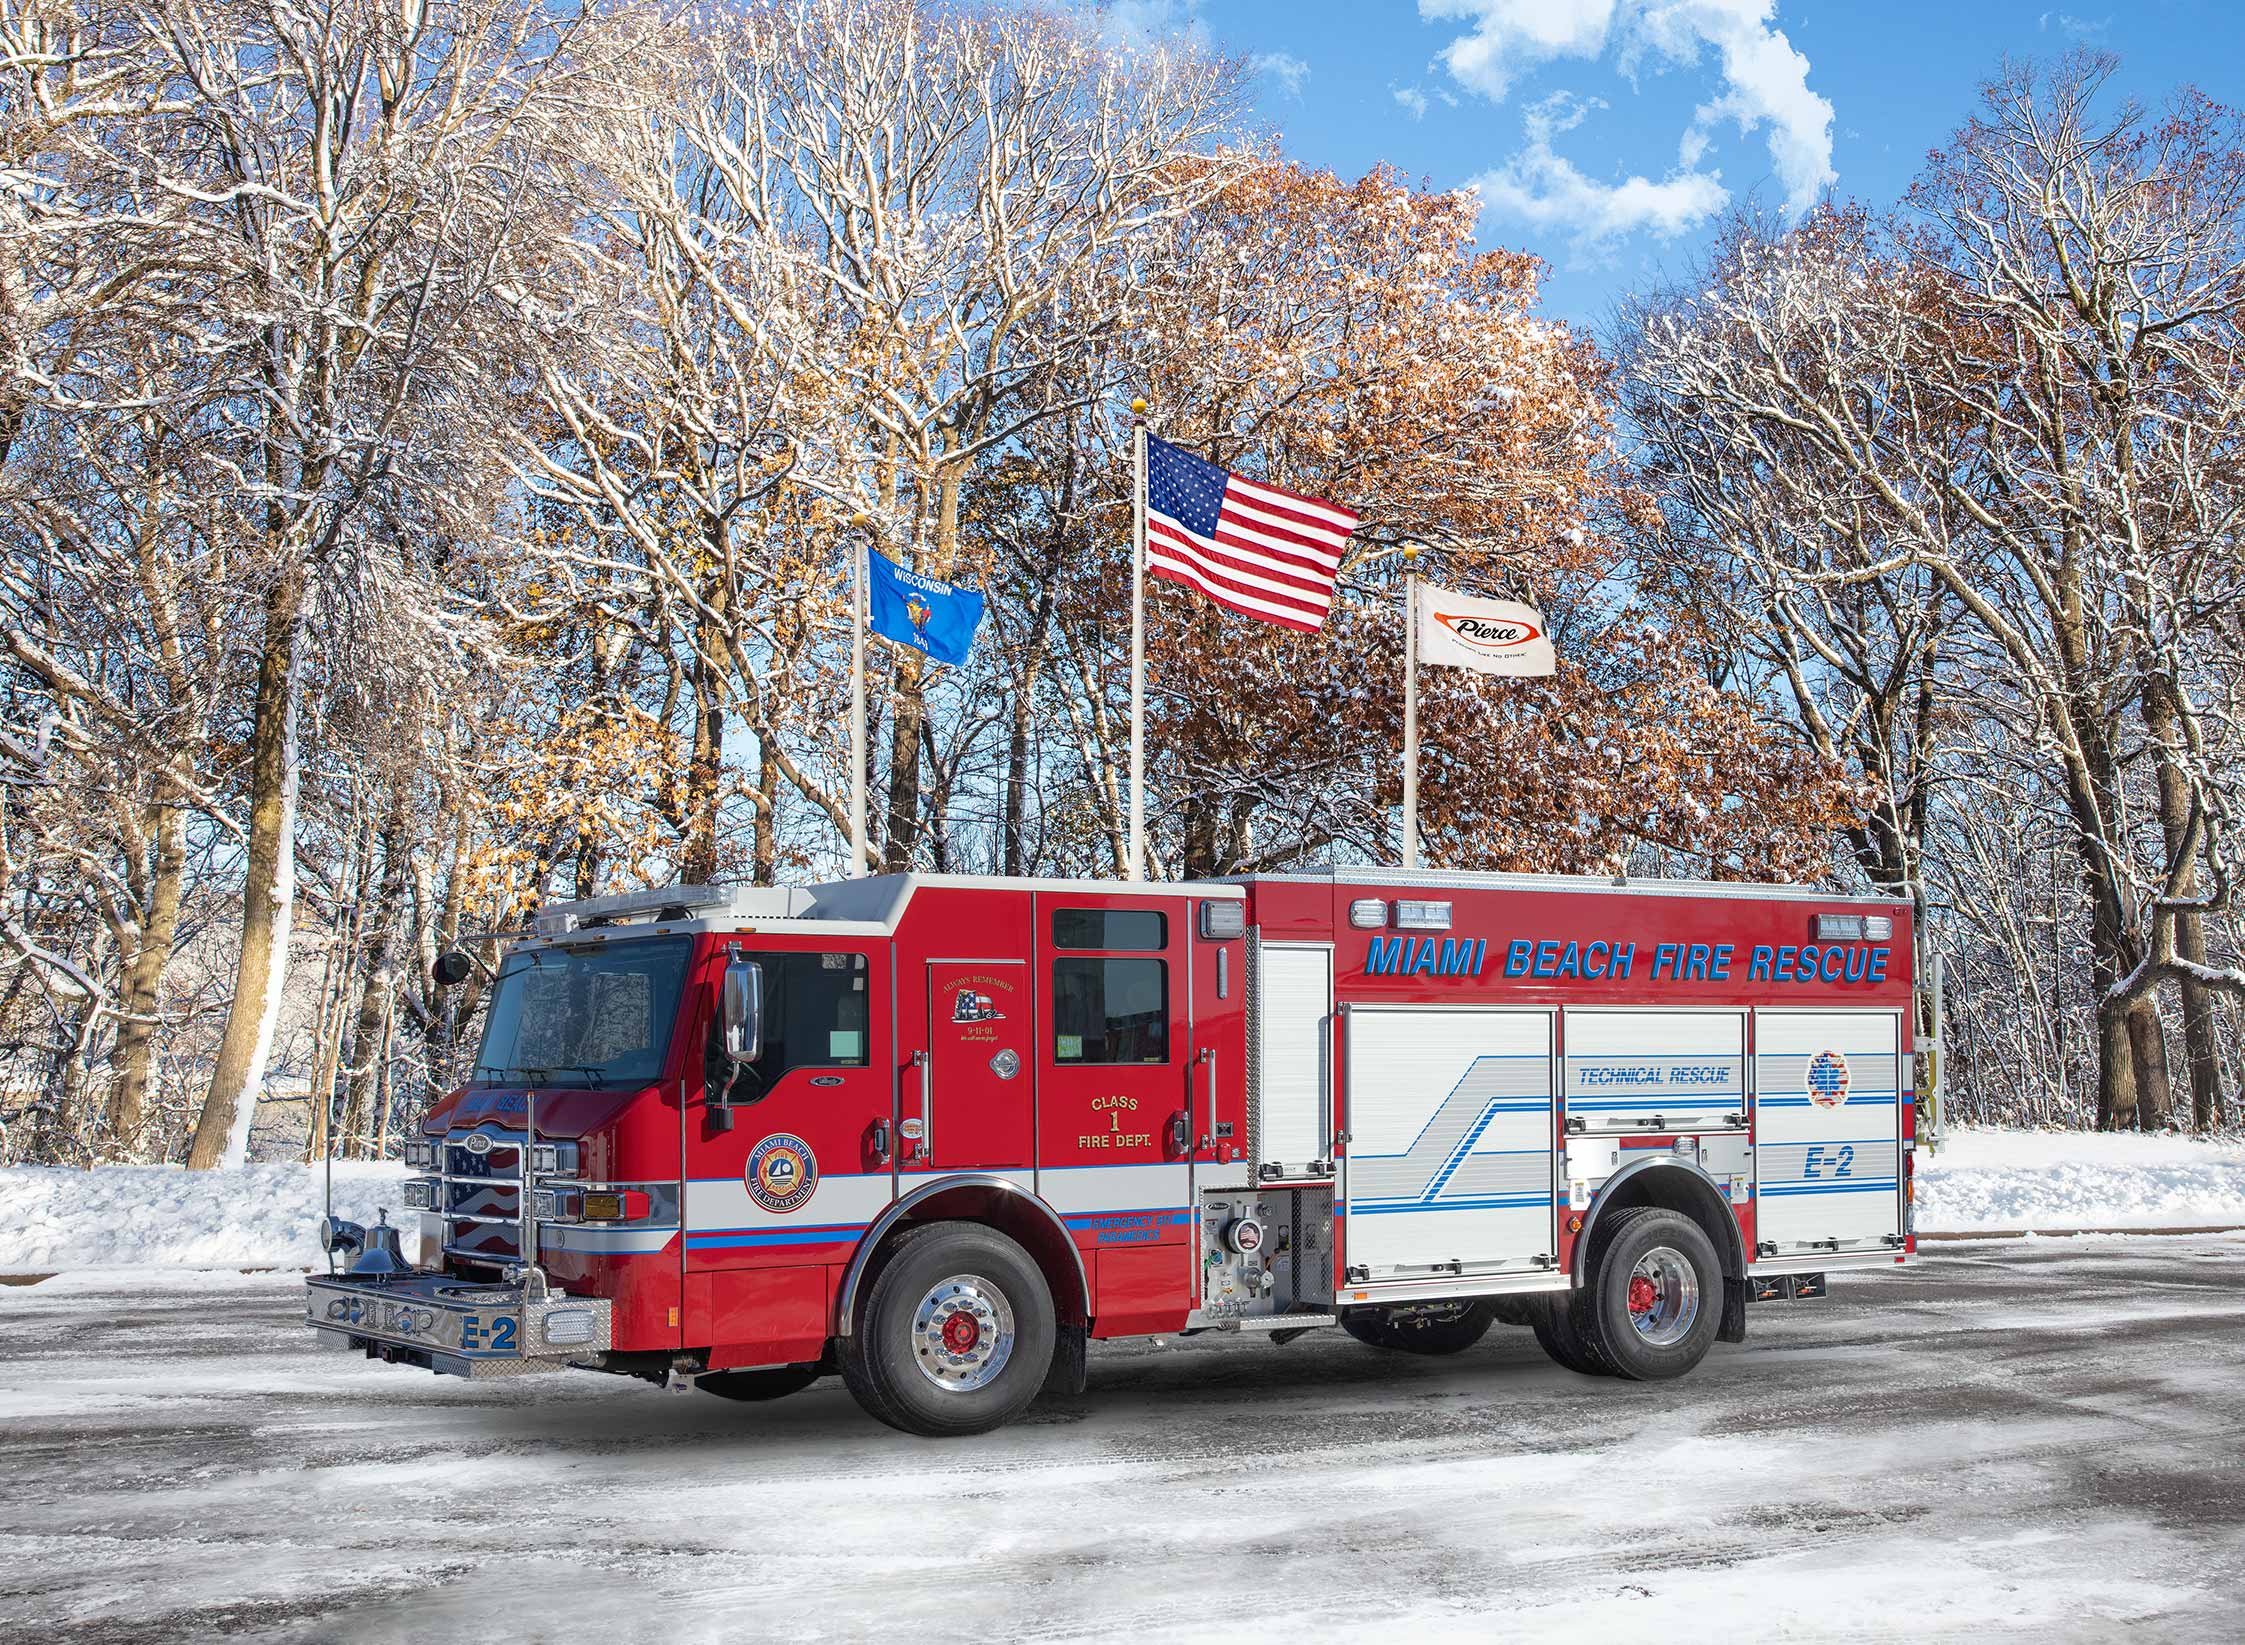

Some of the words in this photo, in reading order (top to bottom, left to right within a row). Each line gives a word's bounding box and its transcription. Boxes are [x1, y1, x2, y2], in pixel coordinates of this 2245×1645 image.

[894, 567, 953, 596] WISCONSIN
[1456, 619, 1518, 640] Pierce
[1364, 935, 1487, 977] MIAMI
[1503, 939, 1635, 980] BEACH
[1649, 943, 1734, 982] FIRE
[1746, 945, 1891, 984] RESCUE
[972, 975, 1016, 993] REMEMBER
[1579, 1067, 1664, 1086] TECHNICAL
[1669, 1066, 1731, 1085] RESCUE
[1091, 1095, 1138, 1112] CLASS
[1109, 1111, 1120, 1132] 1
[754, 1138, 781, 1161] MIAMI
[783, 1138, 809, 1161] BEACH
[1078, 1135, 1110, 1149] FIRE
[1115, 1133, 1152, 1148] DEPT.
[1803, 1145, 1855, 1178] E-2
[750, 1177, 764, 1196] FIRE
[763, 1176, 813, 1208] DEPARTMENT
[1092, 1215, 1154, 1230] EMERGENCY
[1097, 1229, 1160, 1244] PARAMEDICS
[462, 1315, 517, 1350] E-2
